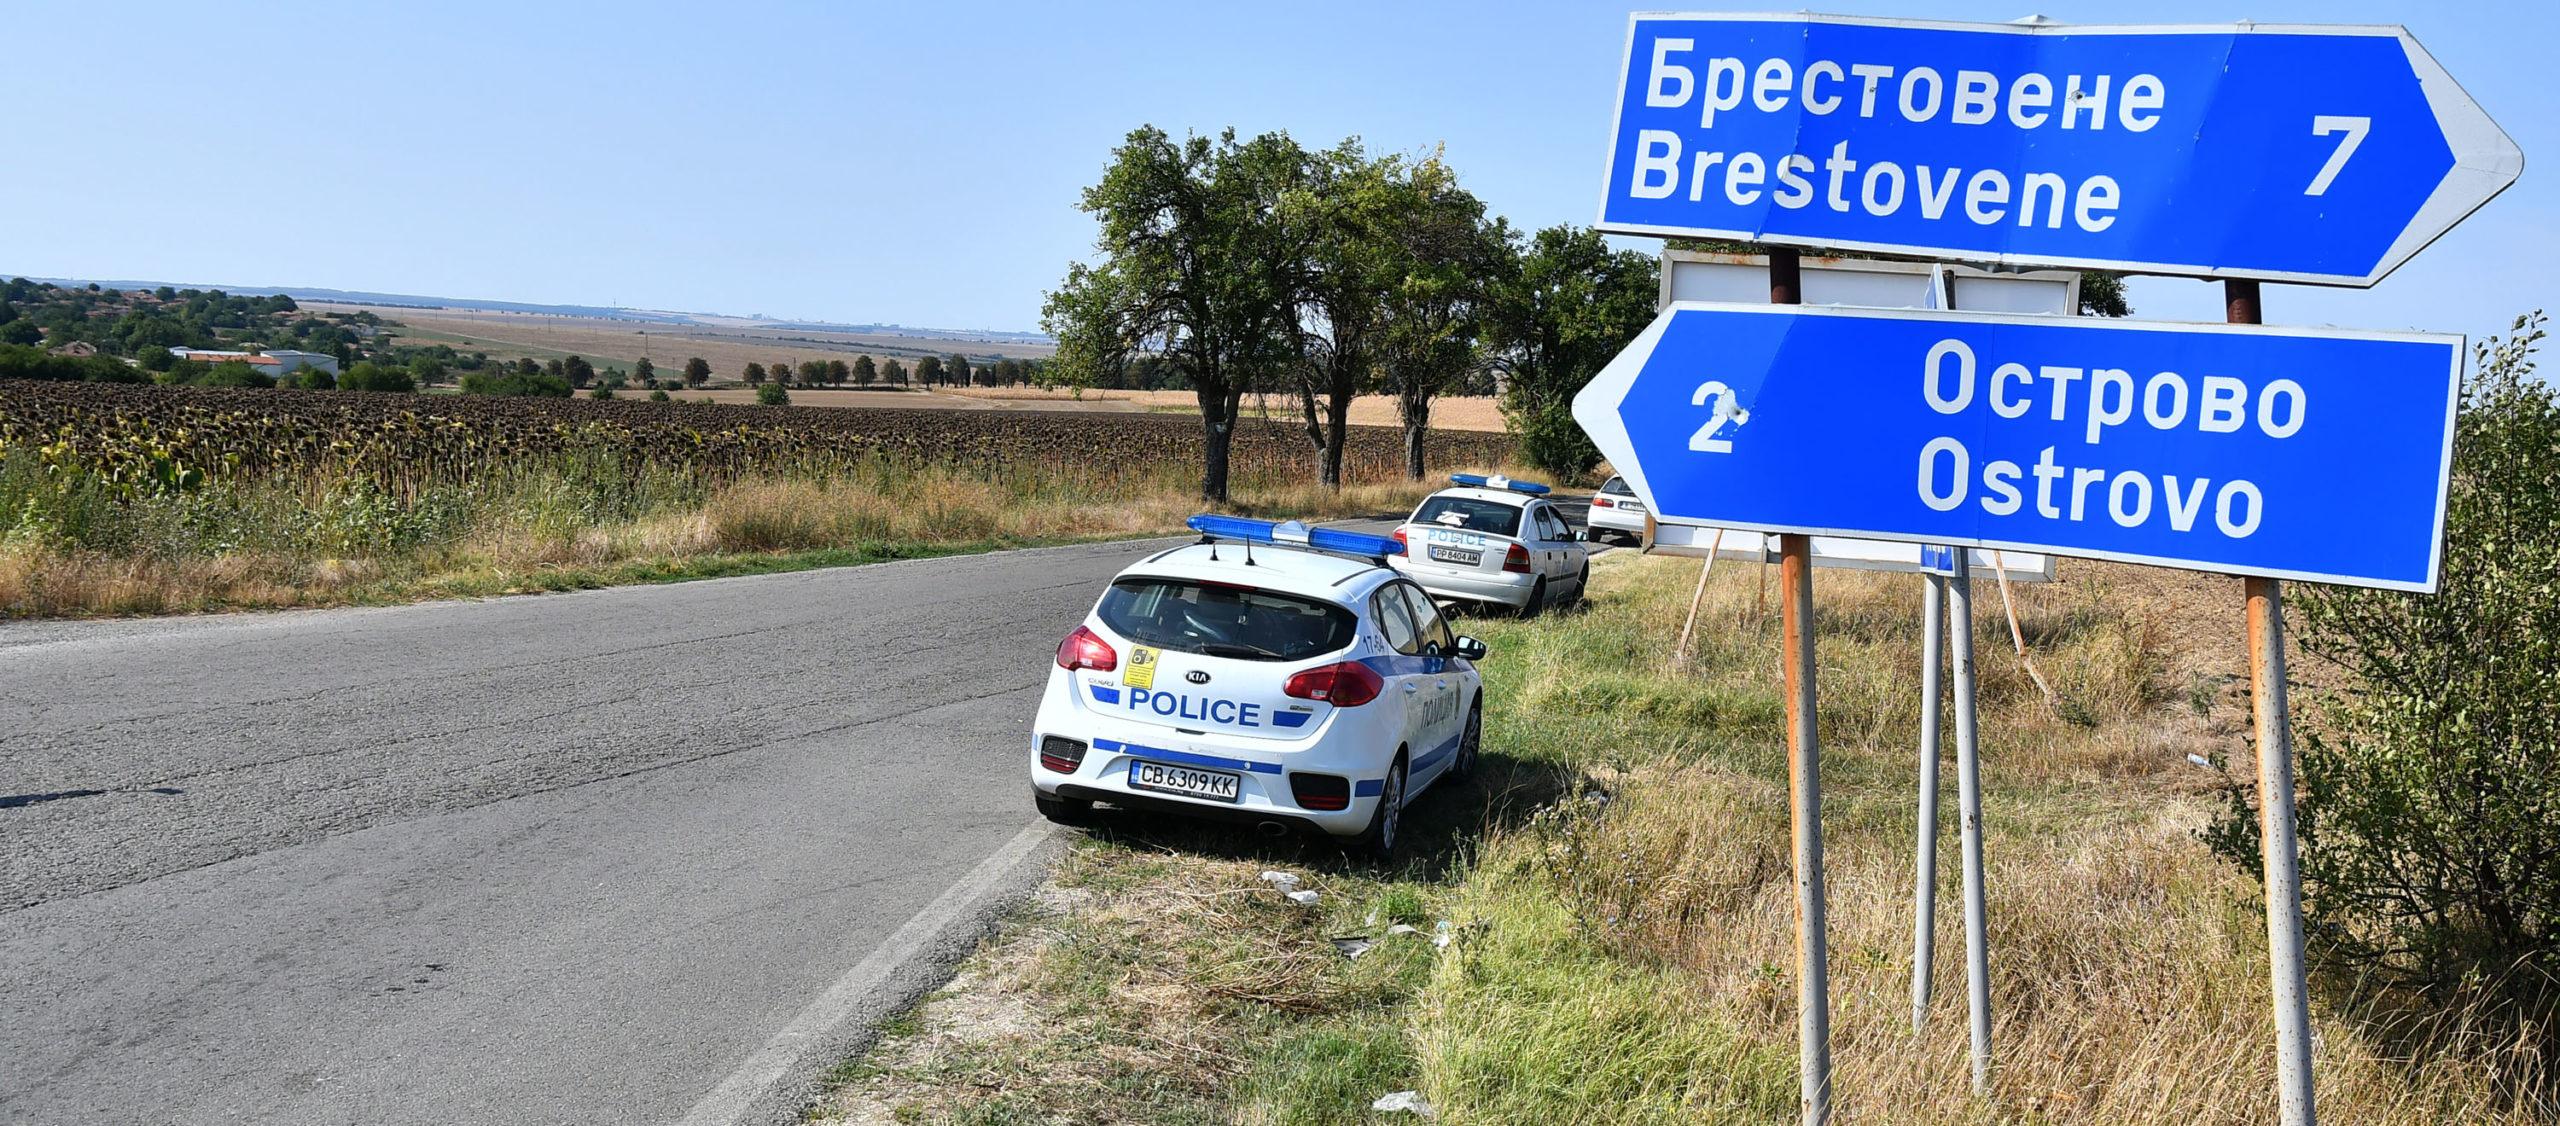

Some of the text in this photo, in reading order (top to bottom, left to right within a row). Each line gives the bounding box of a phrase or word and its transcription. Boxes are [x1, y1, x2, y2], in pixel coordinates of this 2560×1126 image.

[1646, 37, 2165, 132] Брестовене
[1630, 129, 2120, 233] Brestovene
[2304, 115, 2371, 196] 7
[1688, 381, 1735, 453] 2
[1923, 338, 2307, 444] Острово
[1918, 436, 2263, 538] Ostrovo
[1428, 528, 1486, 546] POLICE
[1129, 687, 1261, 727] POLICE
[1188, 672, 1207, 682] KIA
[1166, 768, 1209, 791] 6309
